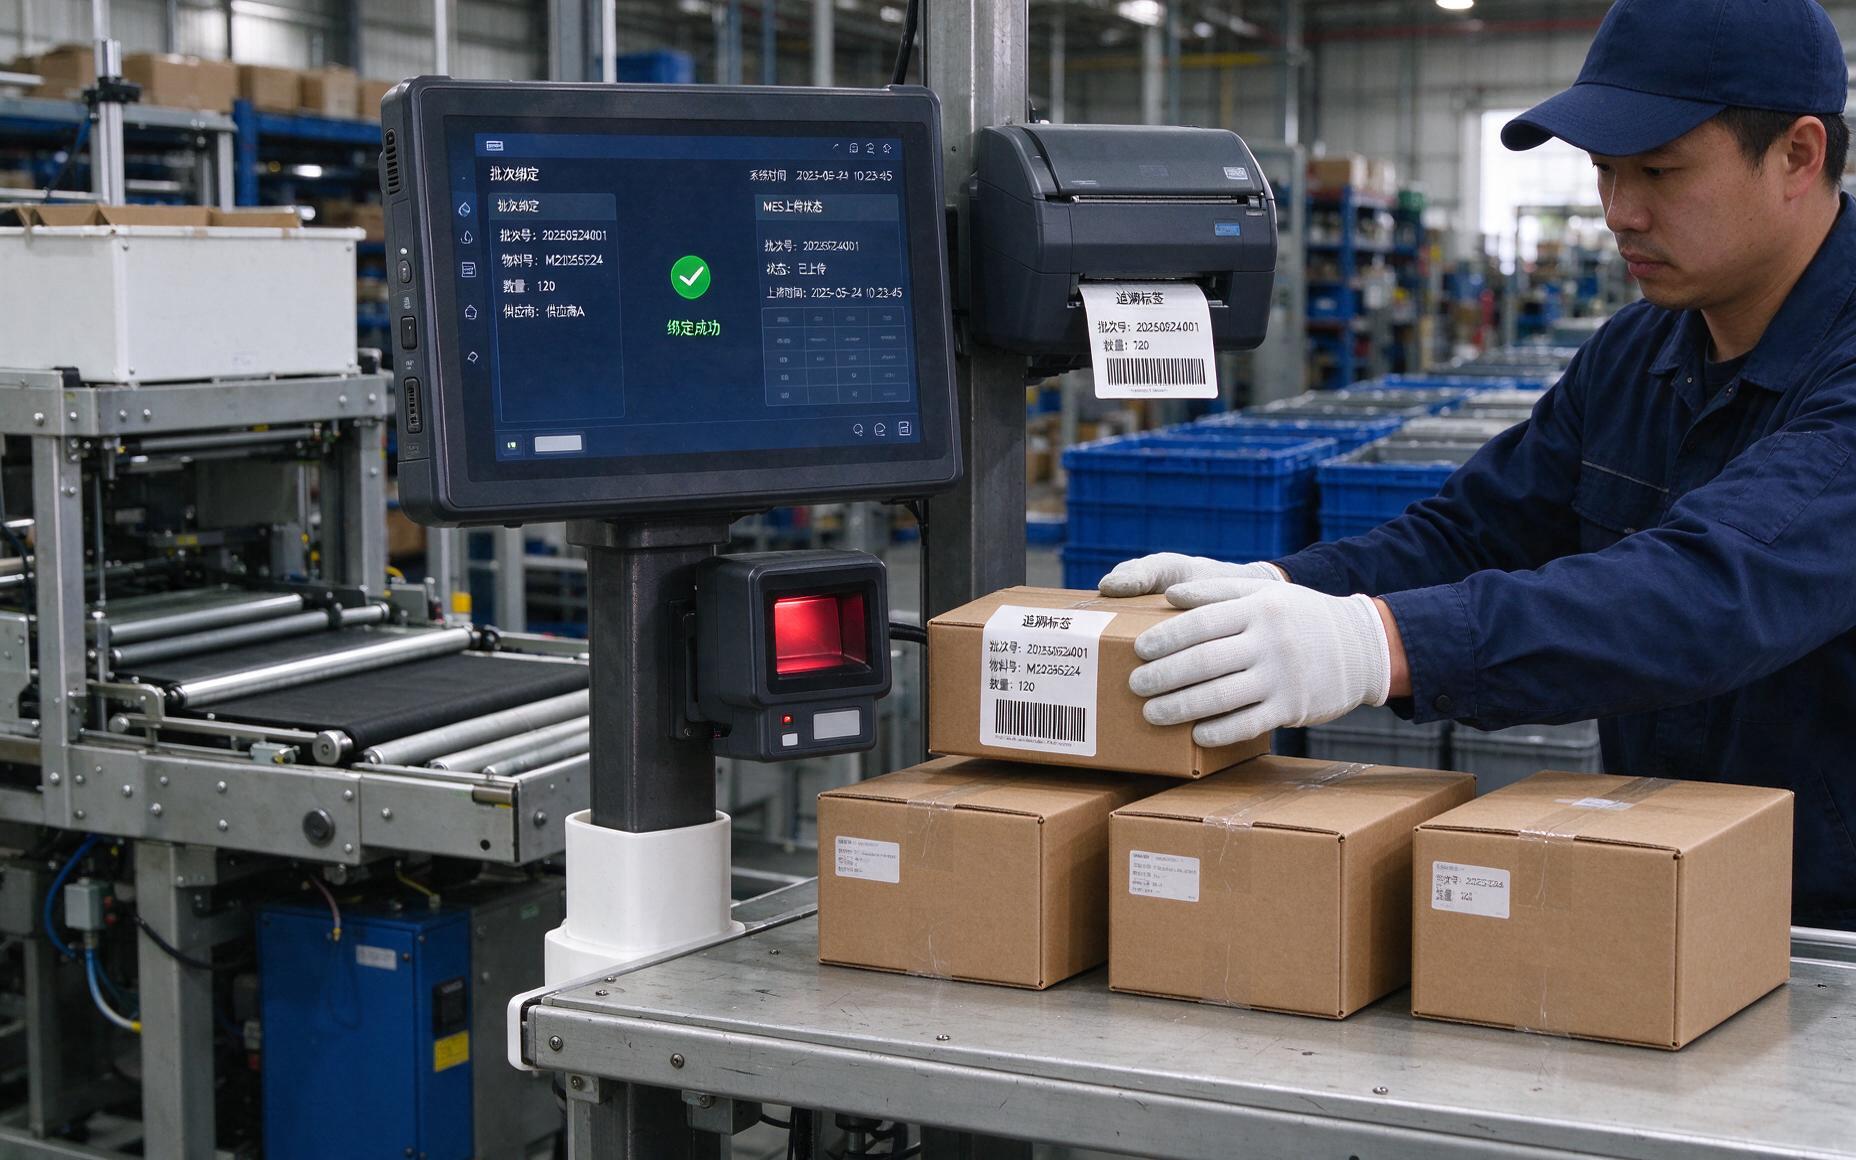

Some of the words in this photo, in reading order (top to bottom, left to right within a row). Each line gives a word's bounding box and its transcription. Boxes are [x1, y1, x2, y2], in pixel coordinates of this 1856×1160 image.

[490, 166, 539, 181] 批次绑定
[537, 281, 556, 292] 120
[667, 319, 721, 336] 绑定成功
[1019, 680, 1035, 692] 120
